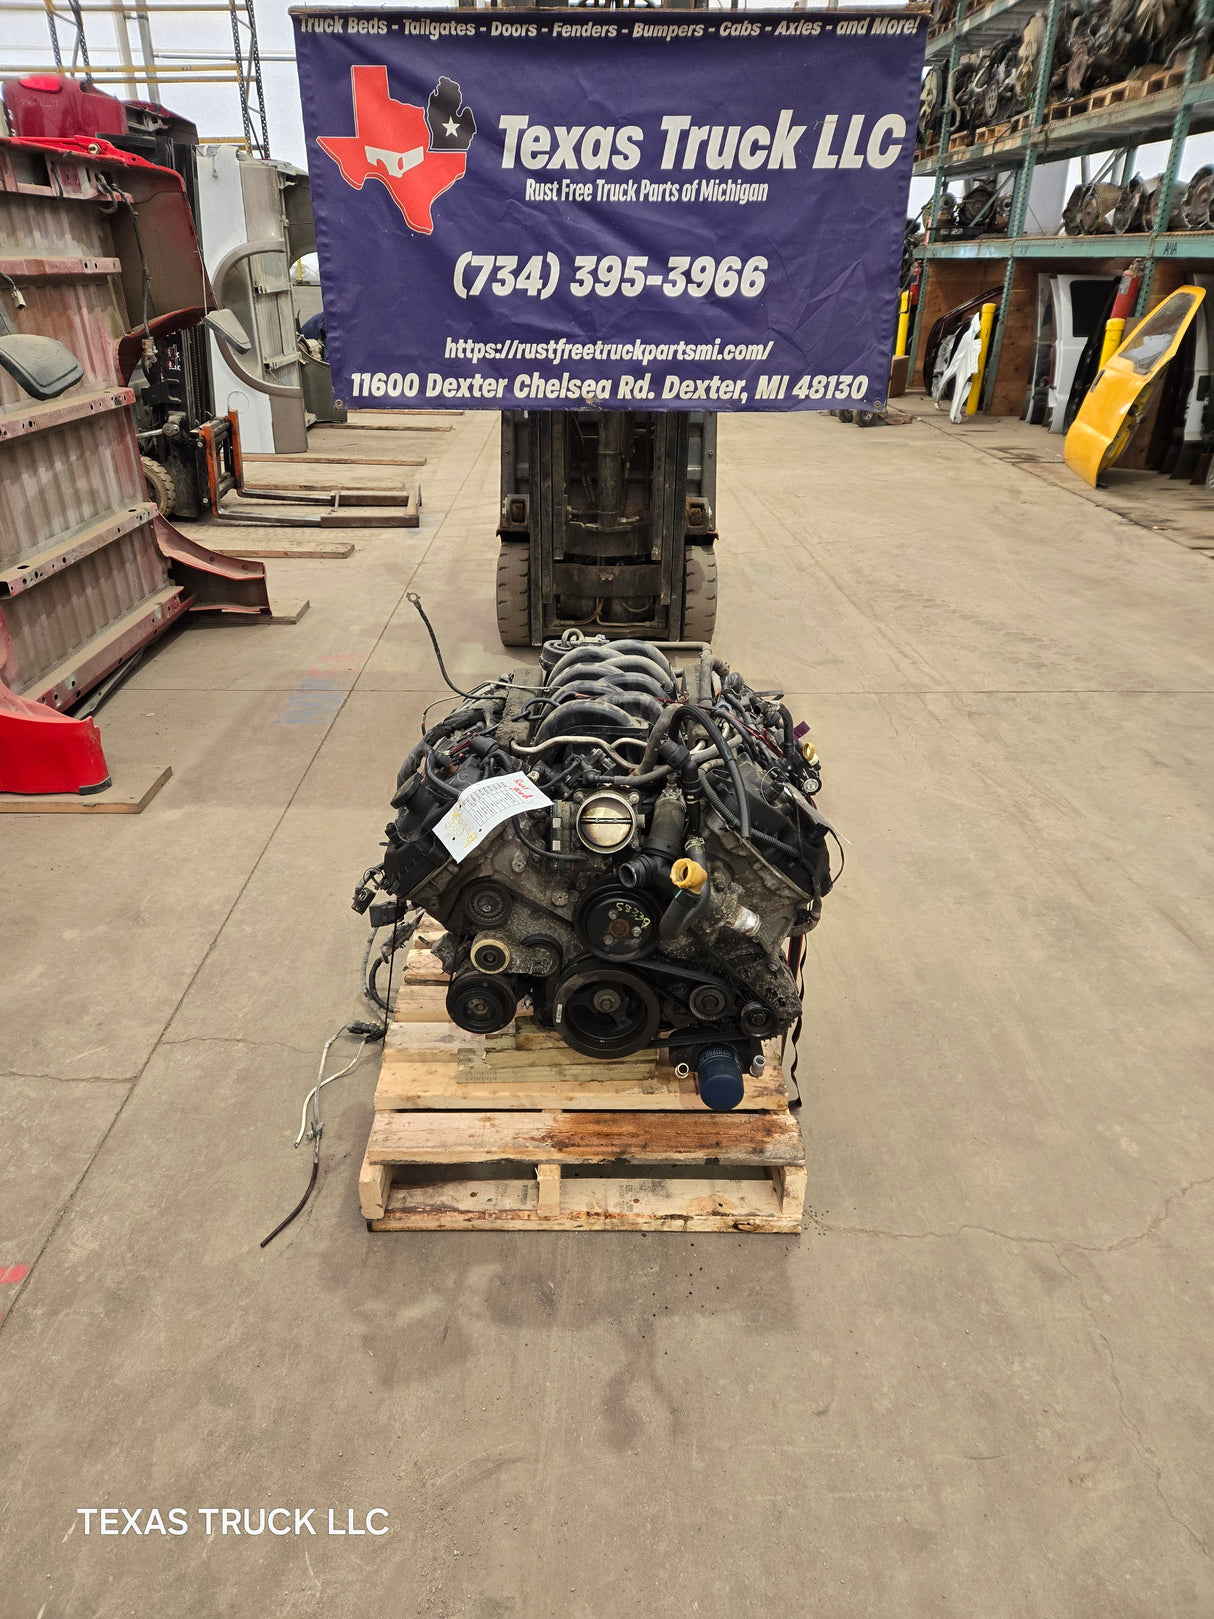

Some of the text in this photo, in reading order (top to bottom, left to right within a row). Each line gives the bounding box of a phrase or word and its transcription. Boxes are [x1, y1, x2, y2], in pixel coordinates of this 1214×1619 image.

[300, 15, 344, 33] Truck
[347, 18, 388, 35] Beds
[403, 19, 476, 41] Tailgates
[490, 21, 538, 37] Doors
[552, 22, 618, 37] Fenders
[632, 22, 705, 42] Bumpers
[719, 20, 762, 36] Cabs
[774, 20, 822, 35] Axles
[836, 18, 870, 35] and
[870, 16, 922, 35] More!
[498, 109, 907, 171] Texas Truck LLC
[525, 178, 769, 205] Rust Free Truck Parts of Michigan
[453, 250, 769, 300] (734) 395-3966
[444, 336, 775, 366] https://rustfreetruckpartsmi.com/
[351, 371, 869, 405] 11600 Dexter Chelsea Rd. Dexter, MI 48130
